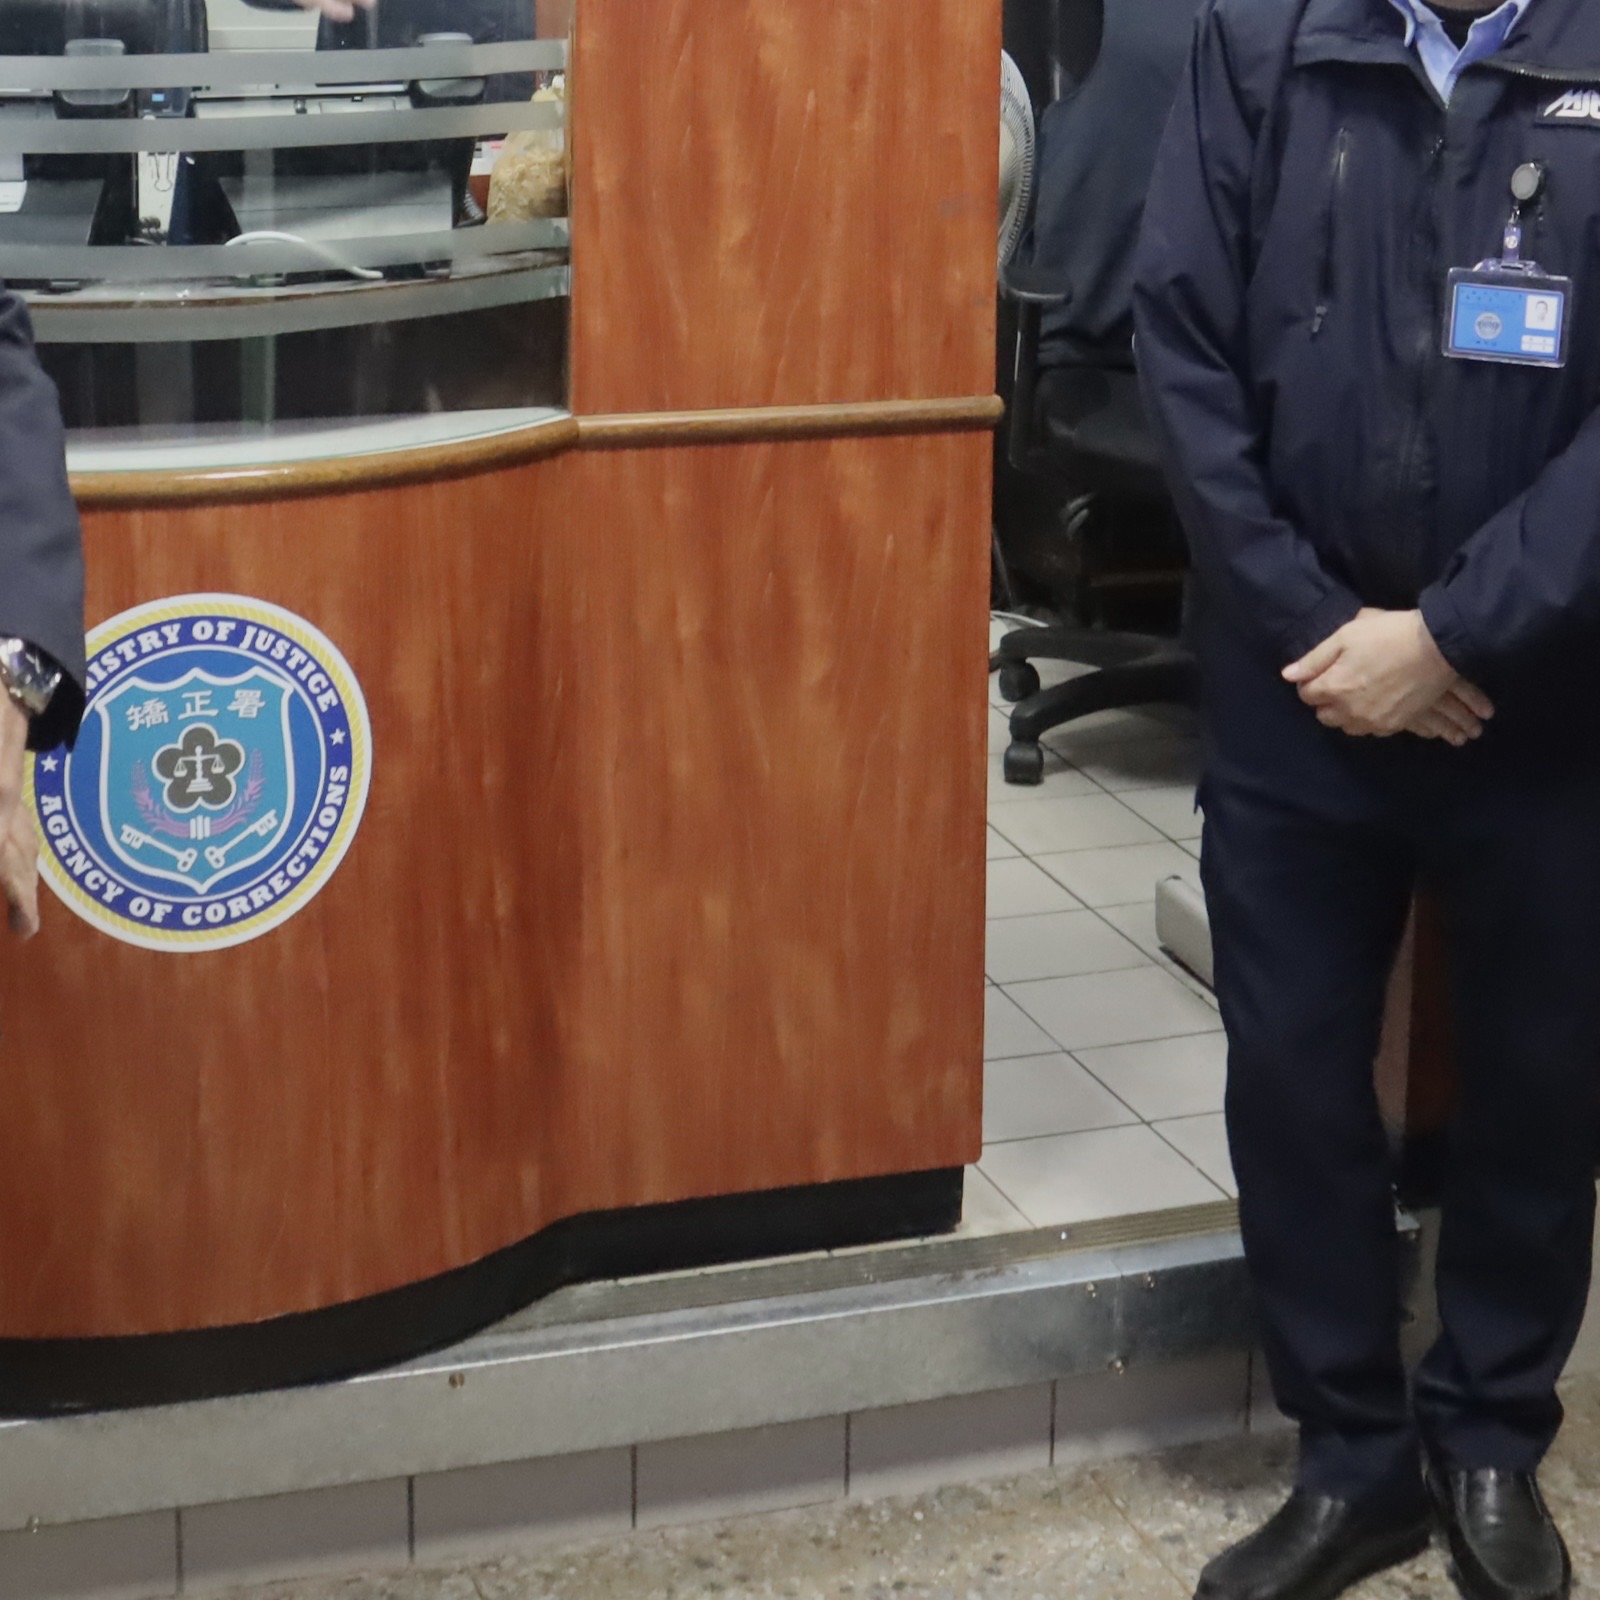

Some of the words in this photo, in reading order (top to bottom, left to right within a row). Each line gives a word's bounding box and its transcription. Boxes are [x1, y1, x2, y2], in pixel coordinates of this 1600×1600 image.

[86, 623, 181, 696] ISTRY
[192, 620, 236, 642] OF
[240, 626, 338, 712] JUSTICE
[126, 689, 265, 731] 矯正署
[41, 795, 124, 903] AGENCY
[129, 898, 172, 924] OF
[182, 765, 348, 927] CORRECTIONS
